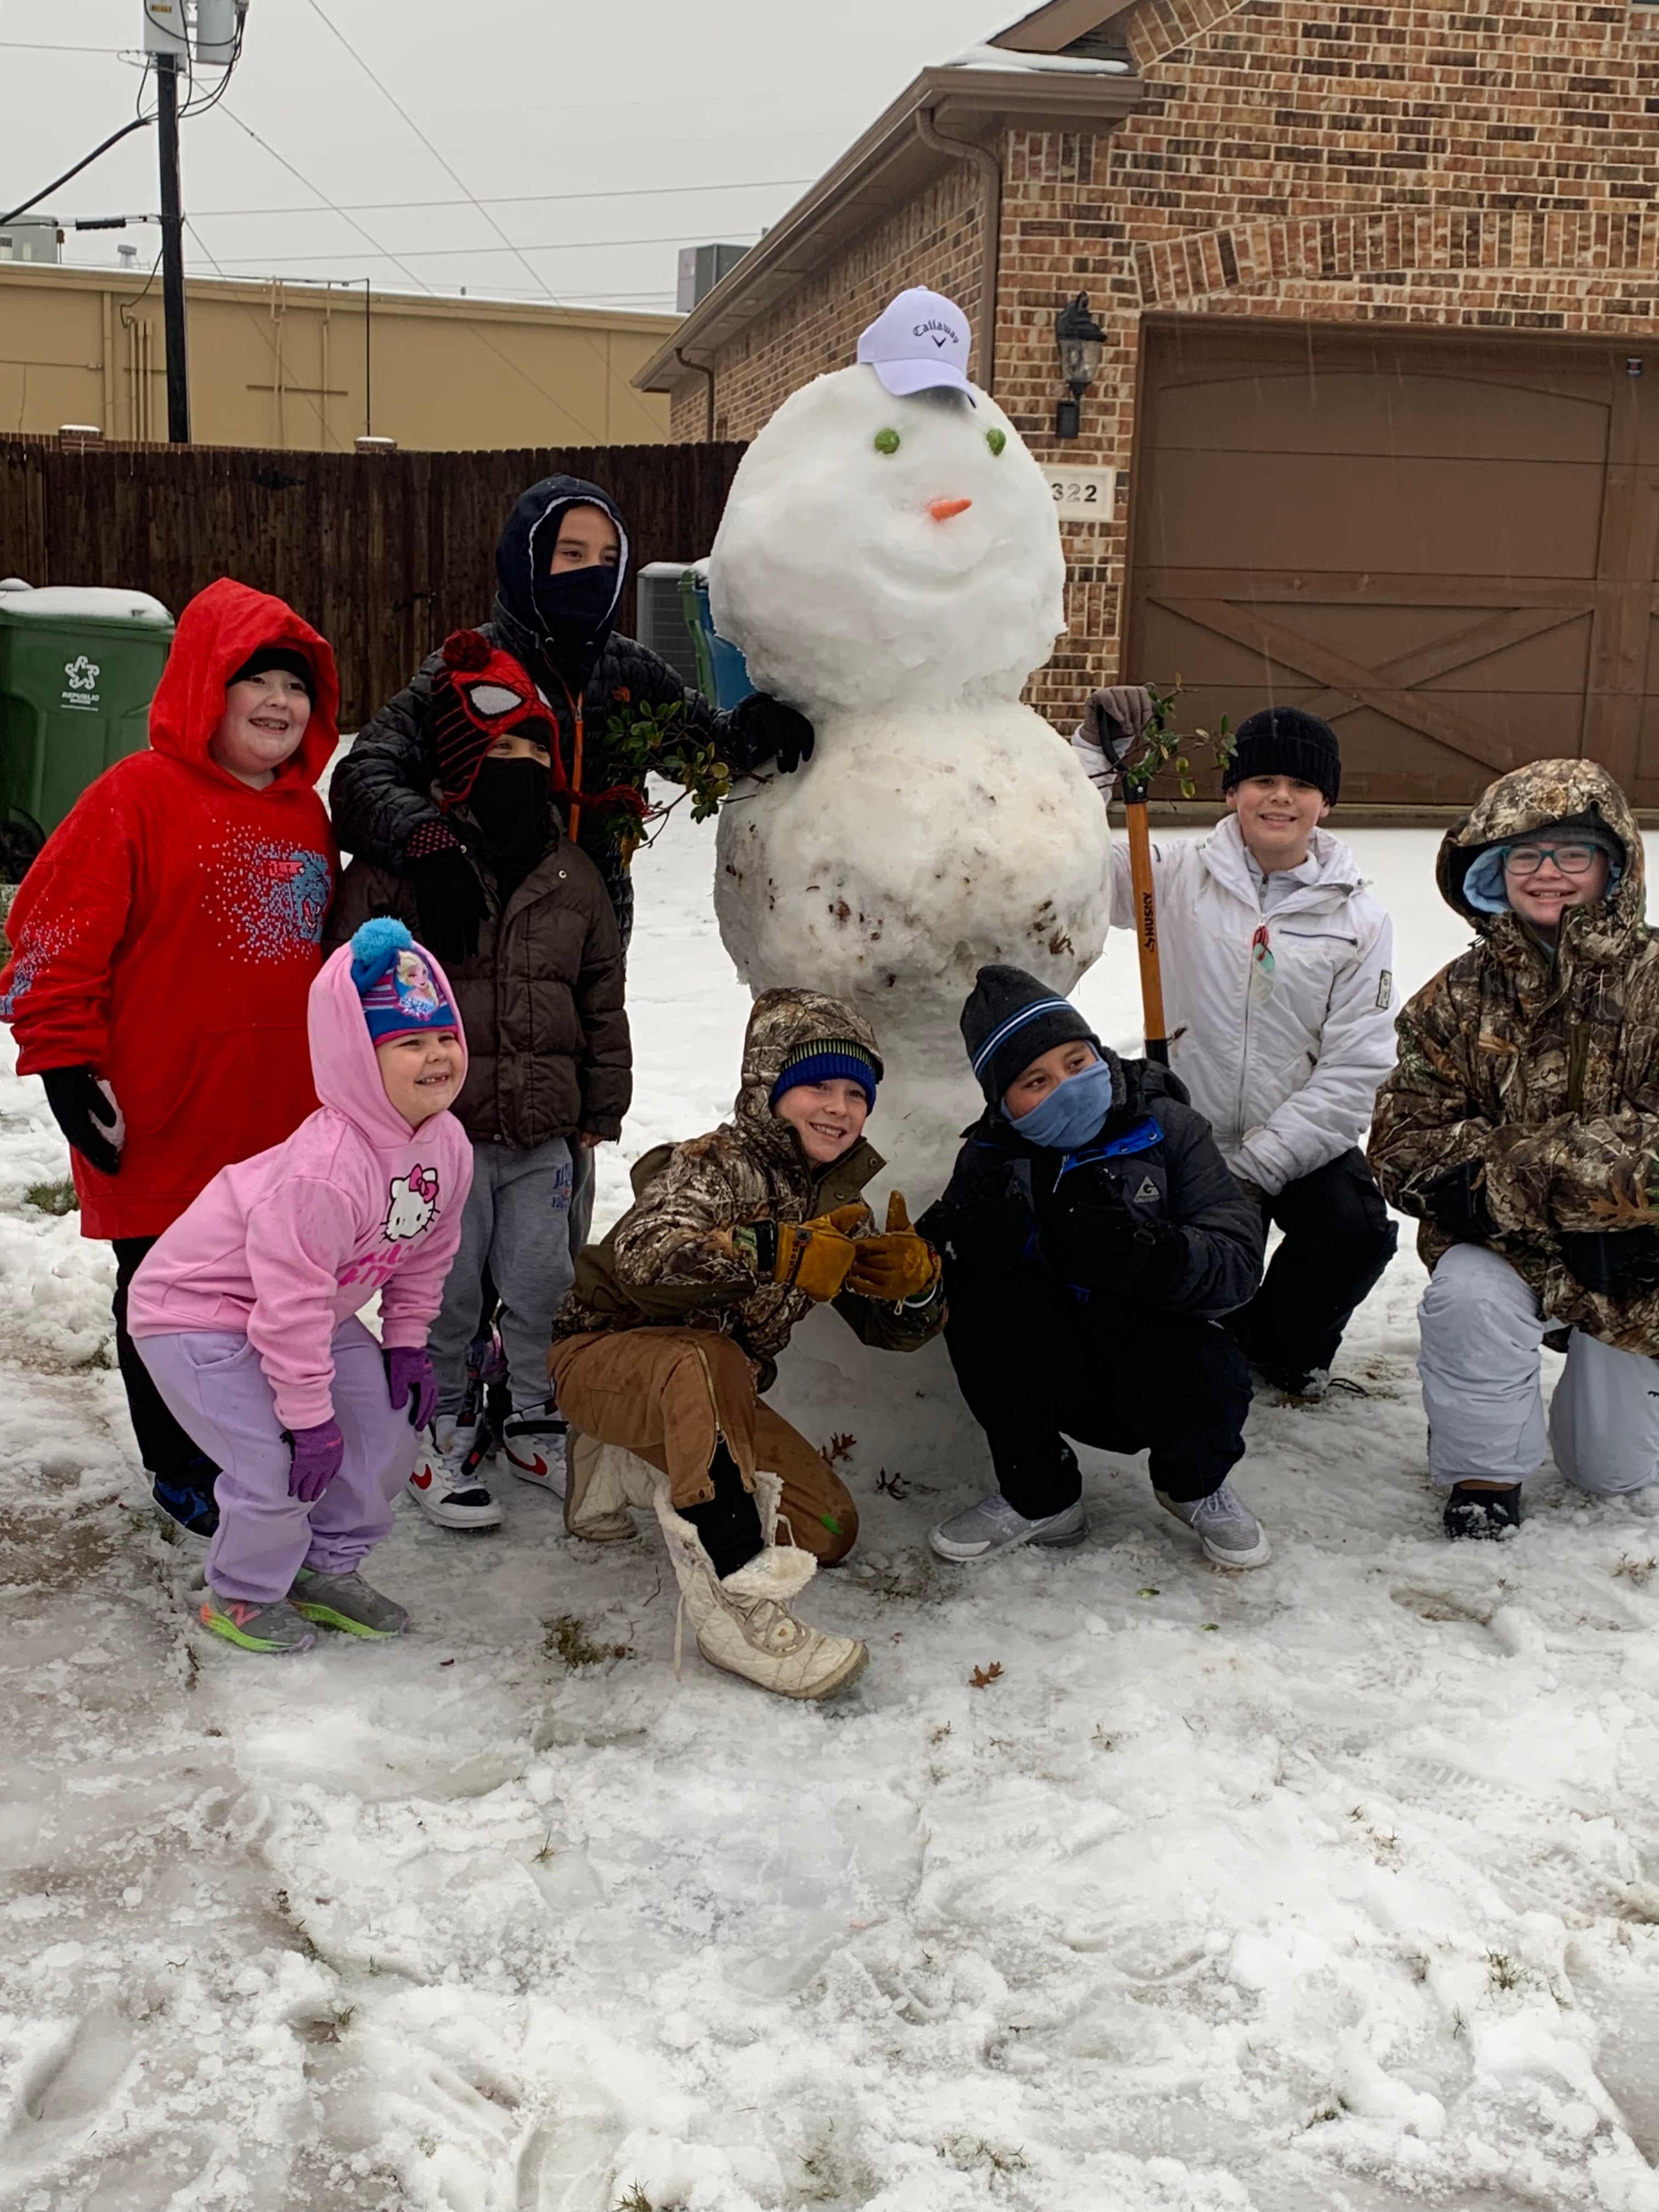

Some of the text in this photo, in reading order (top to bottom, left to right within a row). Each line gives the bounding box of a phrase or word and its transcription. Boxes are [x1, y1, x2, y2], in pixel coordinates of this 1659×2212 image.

[912, 319, 959, 343] Callaway
[62, 691, 99, 702] REPUBLIC
[1143, 892, 1155, 936] HUSKY
